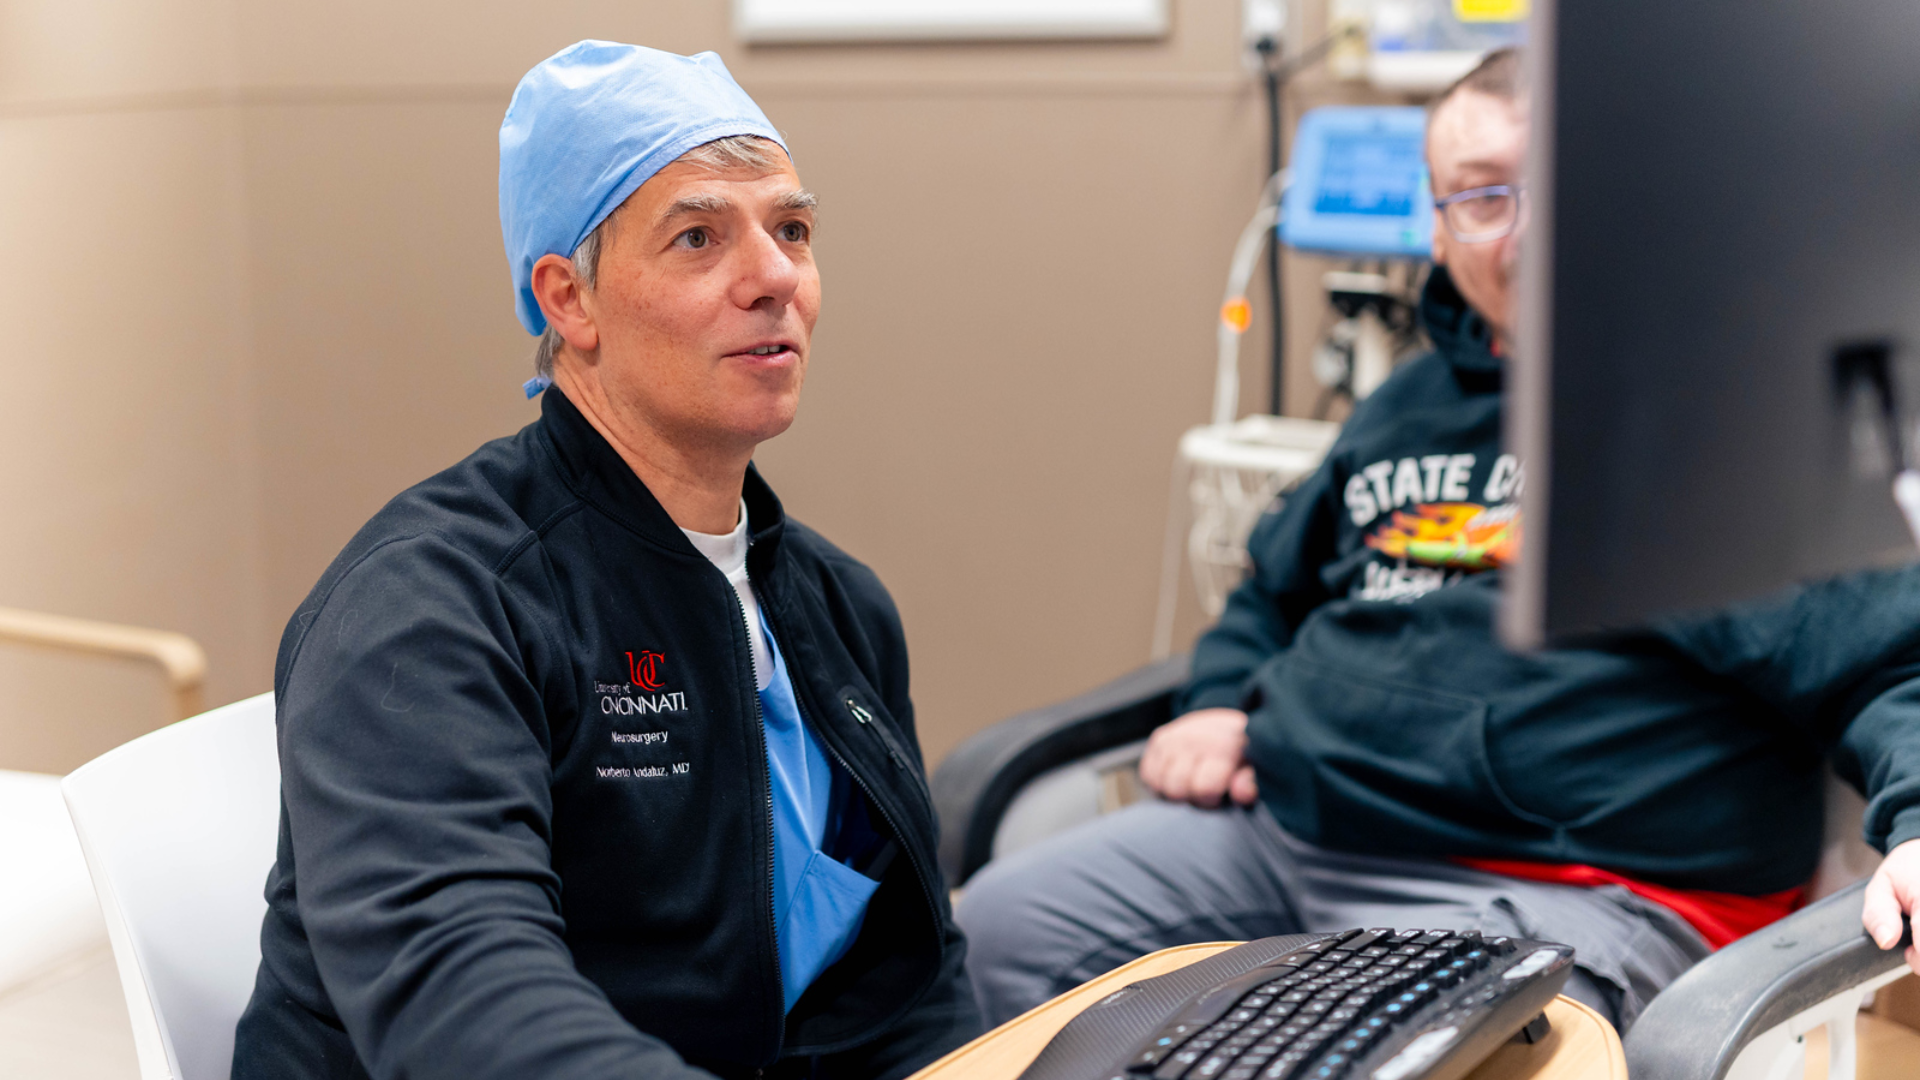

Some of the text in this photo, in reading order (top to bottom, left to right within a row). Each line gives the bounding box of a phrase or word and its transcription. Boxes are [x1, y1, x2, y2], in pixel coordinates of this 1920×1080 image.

[1344, 453, 1476, 528] STATE
[625, 650, 665, 692] UC
[611, 730, 668, 745] Neurosurgery
[672, 762, 690, 775] MD
